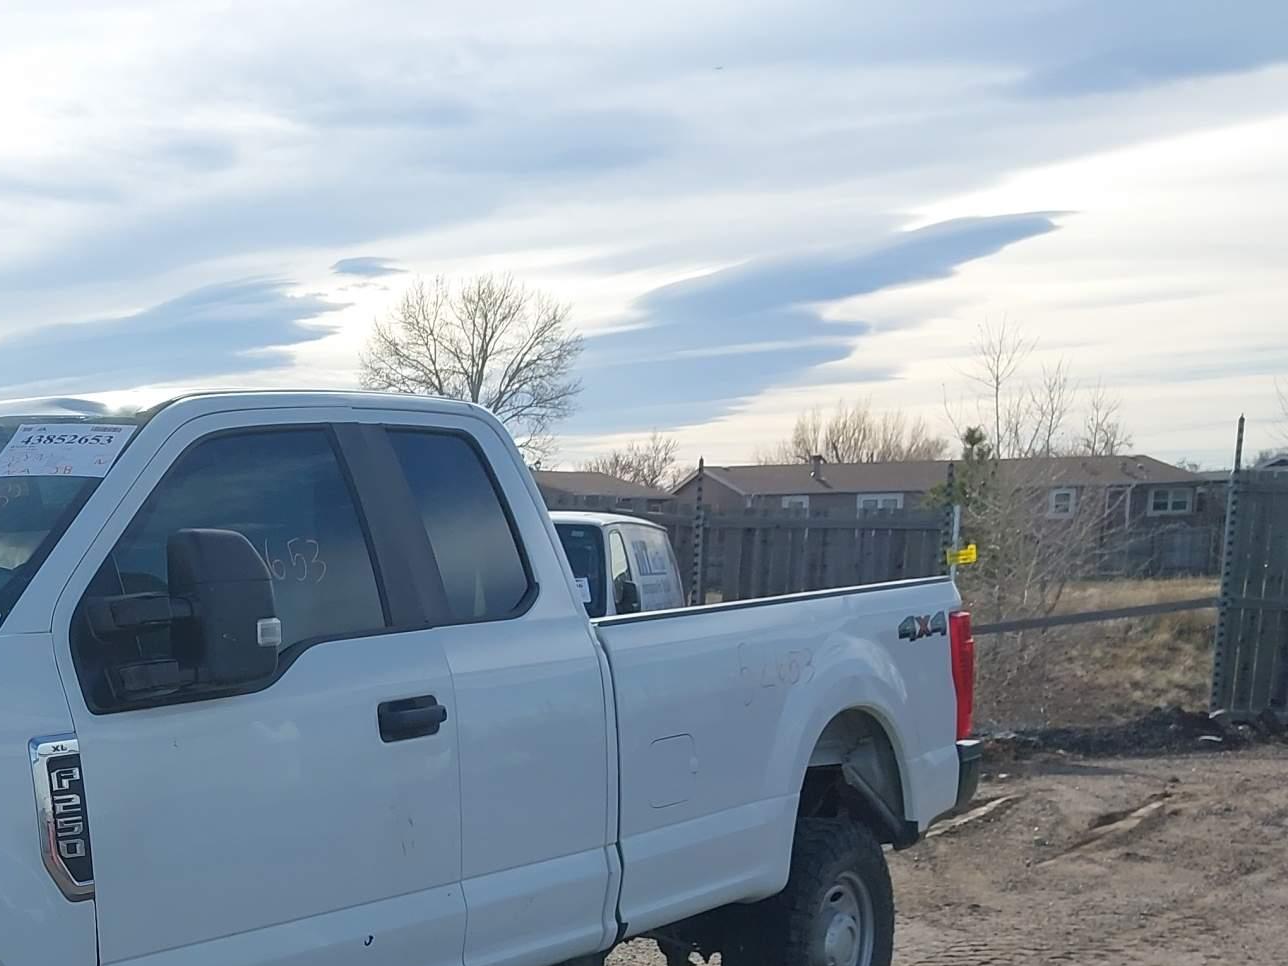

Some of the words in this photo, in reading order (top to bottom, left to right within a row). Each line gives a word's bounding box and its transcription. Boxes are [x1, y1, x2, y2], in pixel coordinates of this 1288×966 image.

[21, 434, 114, 446] 43852653
[264, 537, 327, 583] 653
[51, 744, 68, 753] XL
[50, 767, 86, 859] F250
